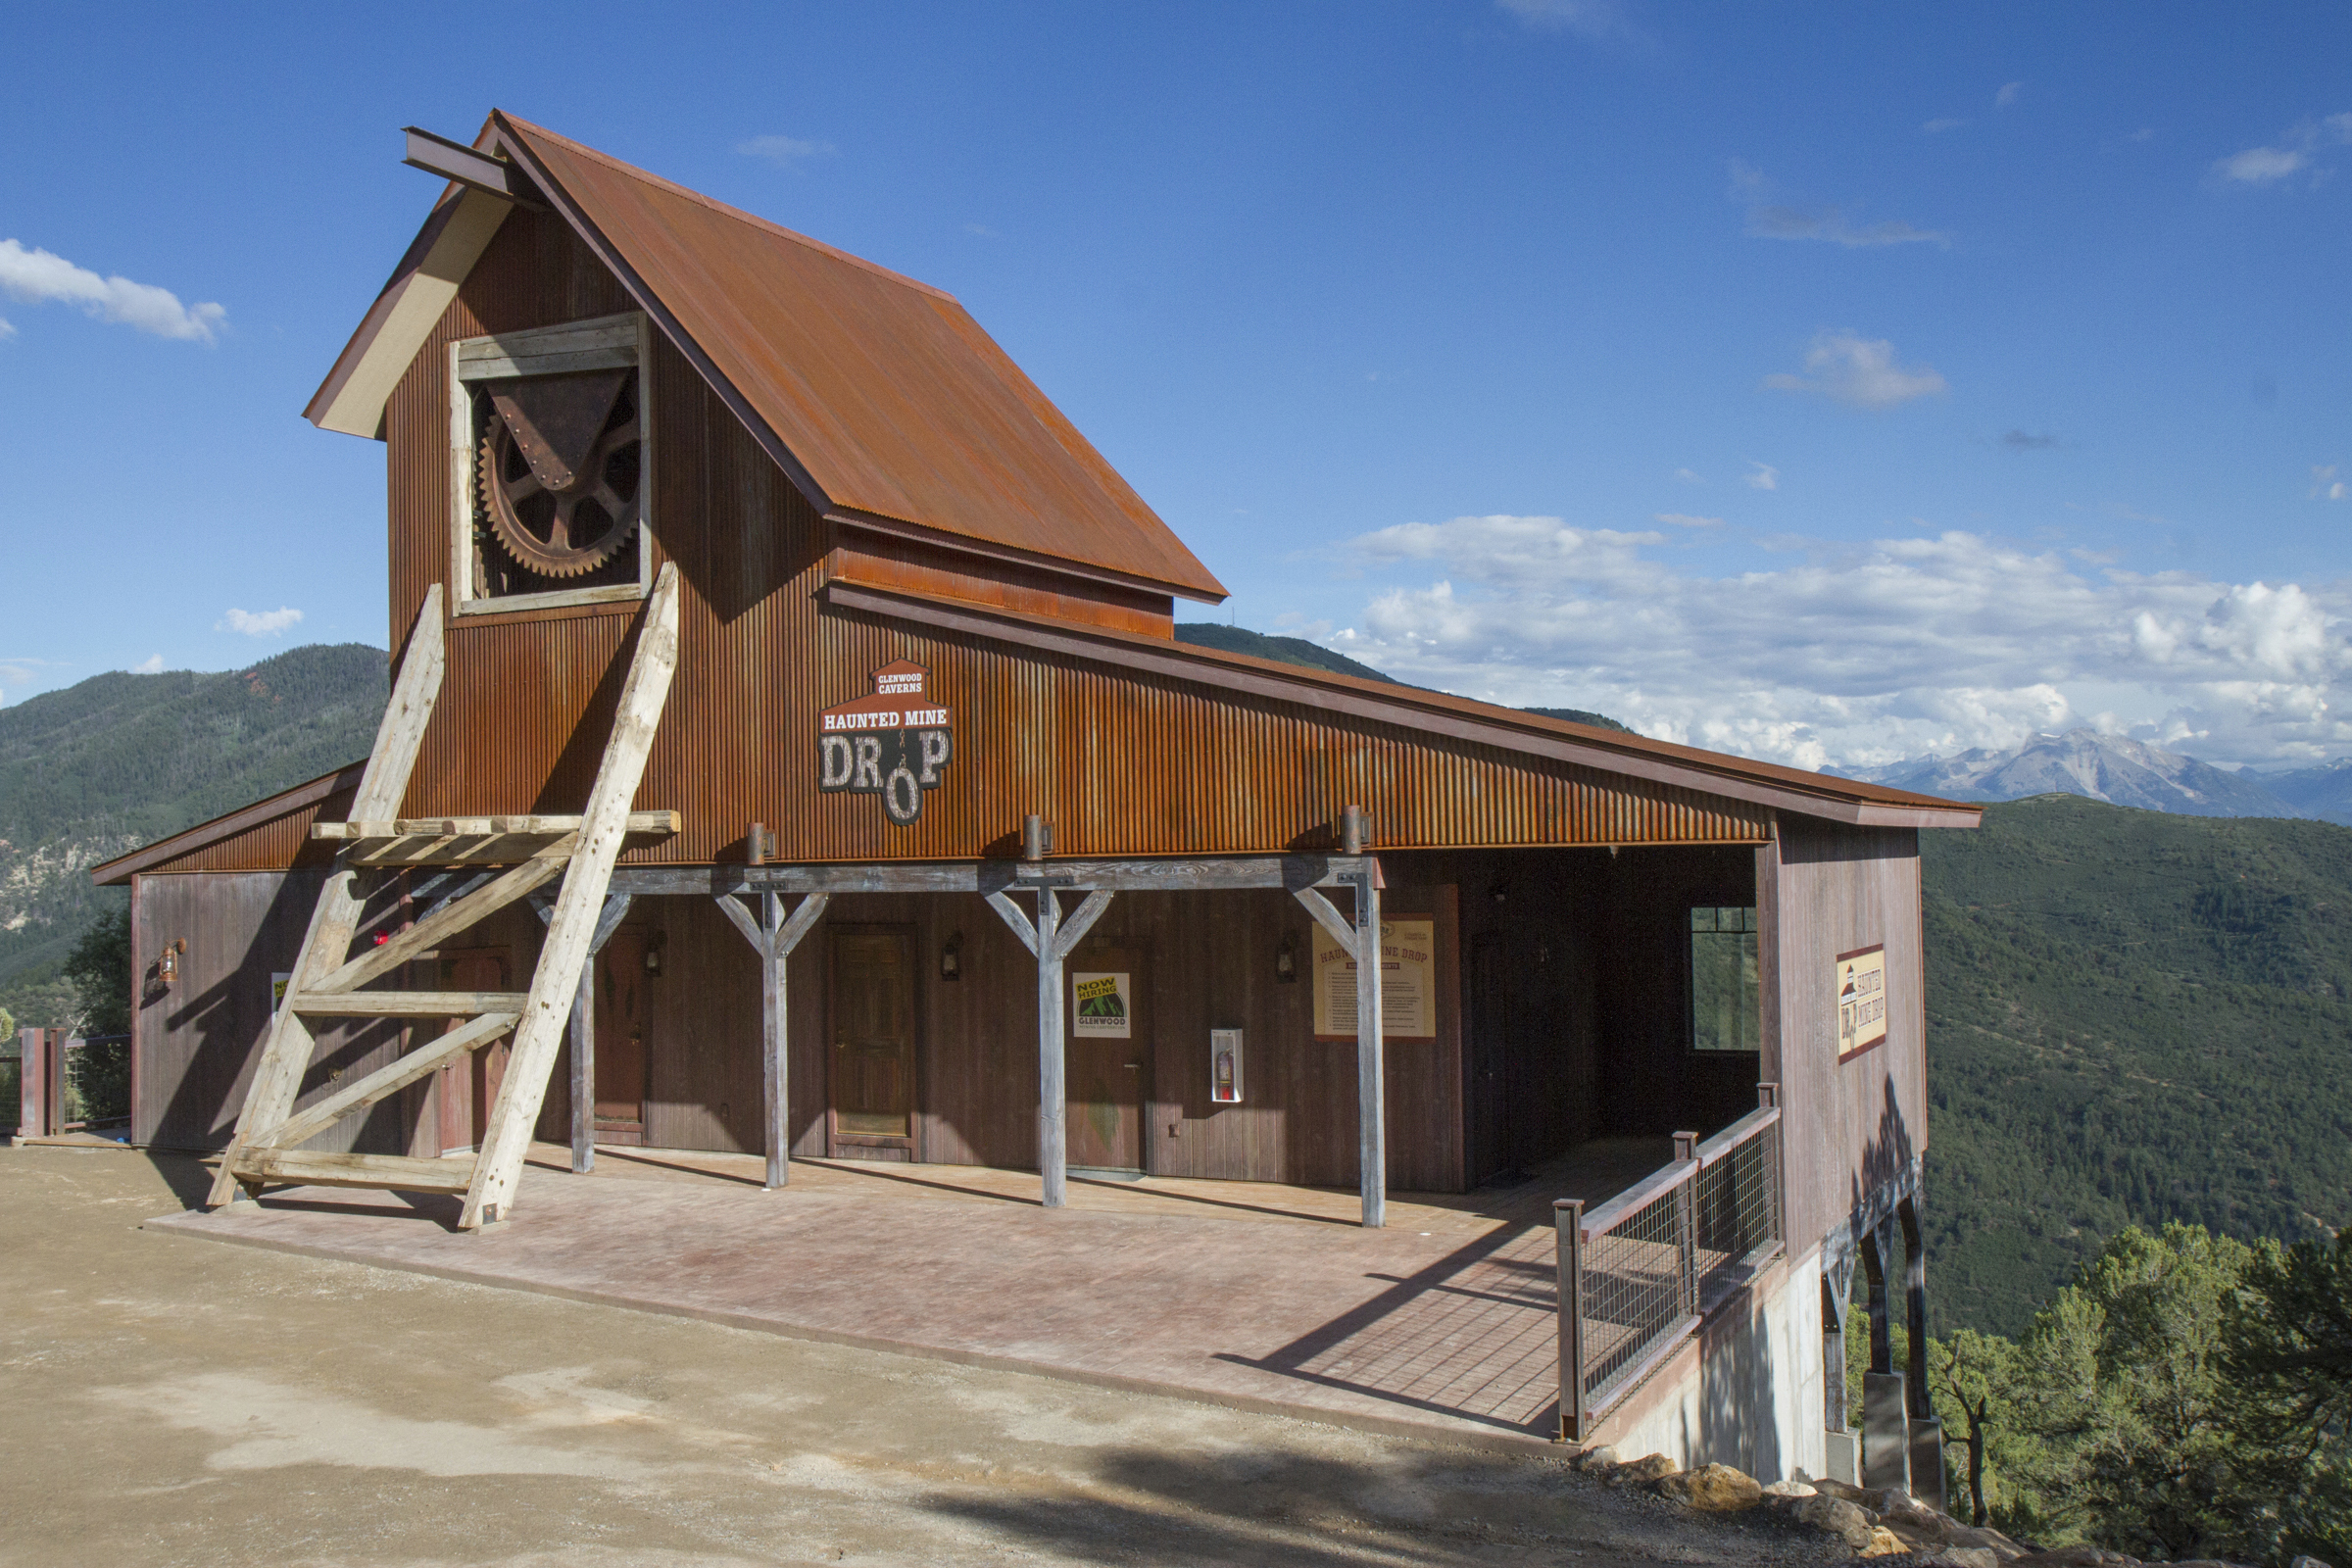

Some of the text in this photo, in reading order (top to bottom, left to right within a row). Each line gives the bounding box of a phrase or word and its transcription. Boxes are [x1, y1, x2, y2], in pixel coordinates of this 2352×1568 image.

[878, 673, 922, 684] GLENWOOD
[878, 683, 922, 695] CAVERNS
[824, 710, 947, 730] HAUNTED MINE
[821, 730, 949, 820] DROP
[1320, 946, 1428, 963] HAUN INE DROP
[274, 981, 288, 990] NO
[1077, 977, 1115, 993] NOW
[1078, 986, 1117, 1000] HIRING
[1078, 1016, 1126, 1026] GLENWOOD
